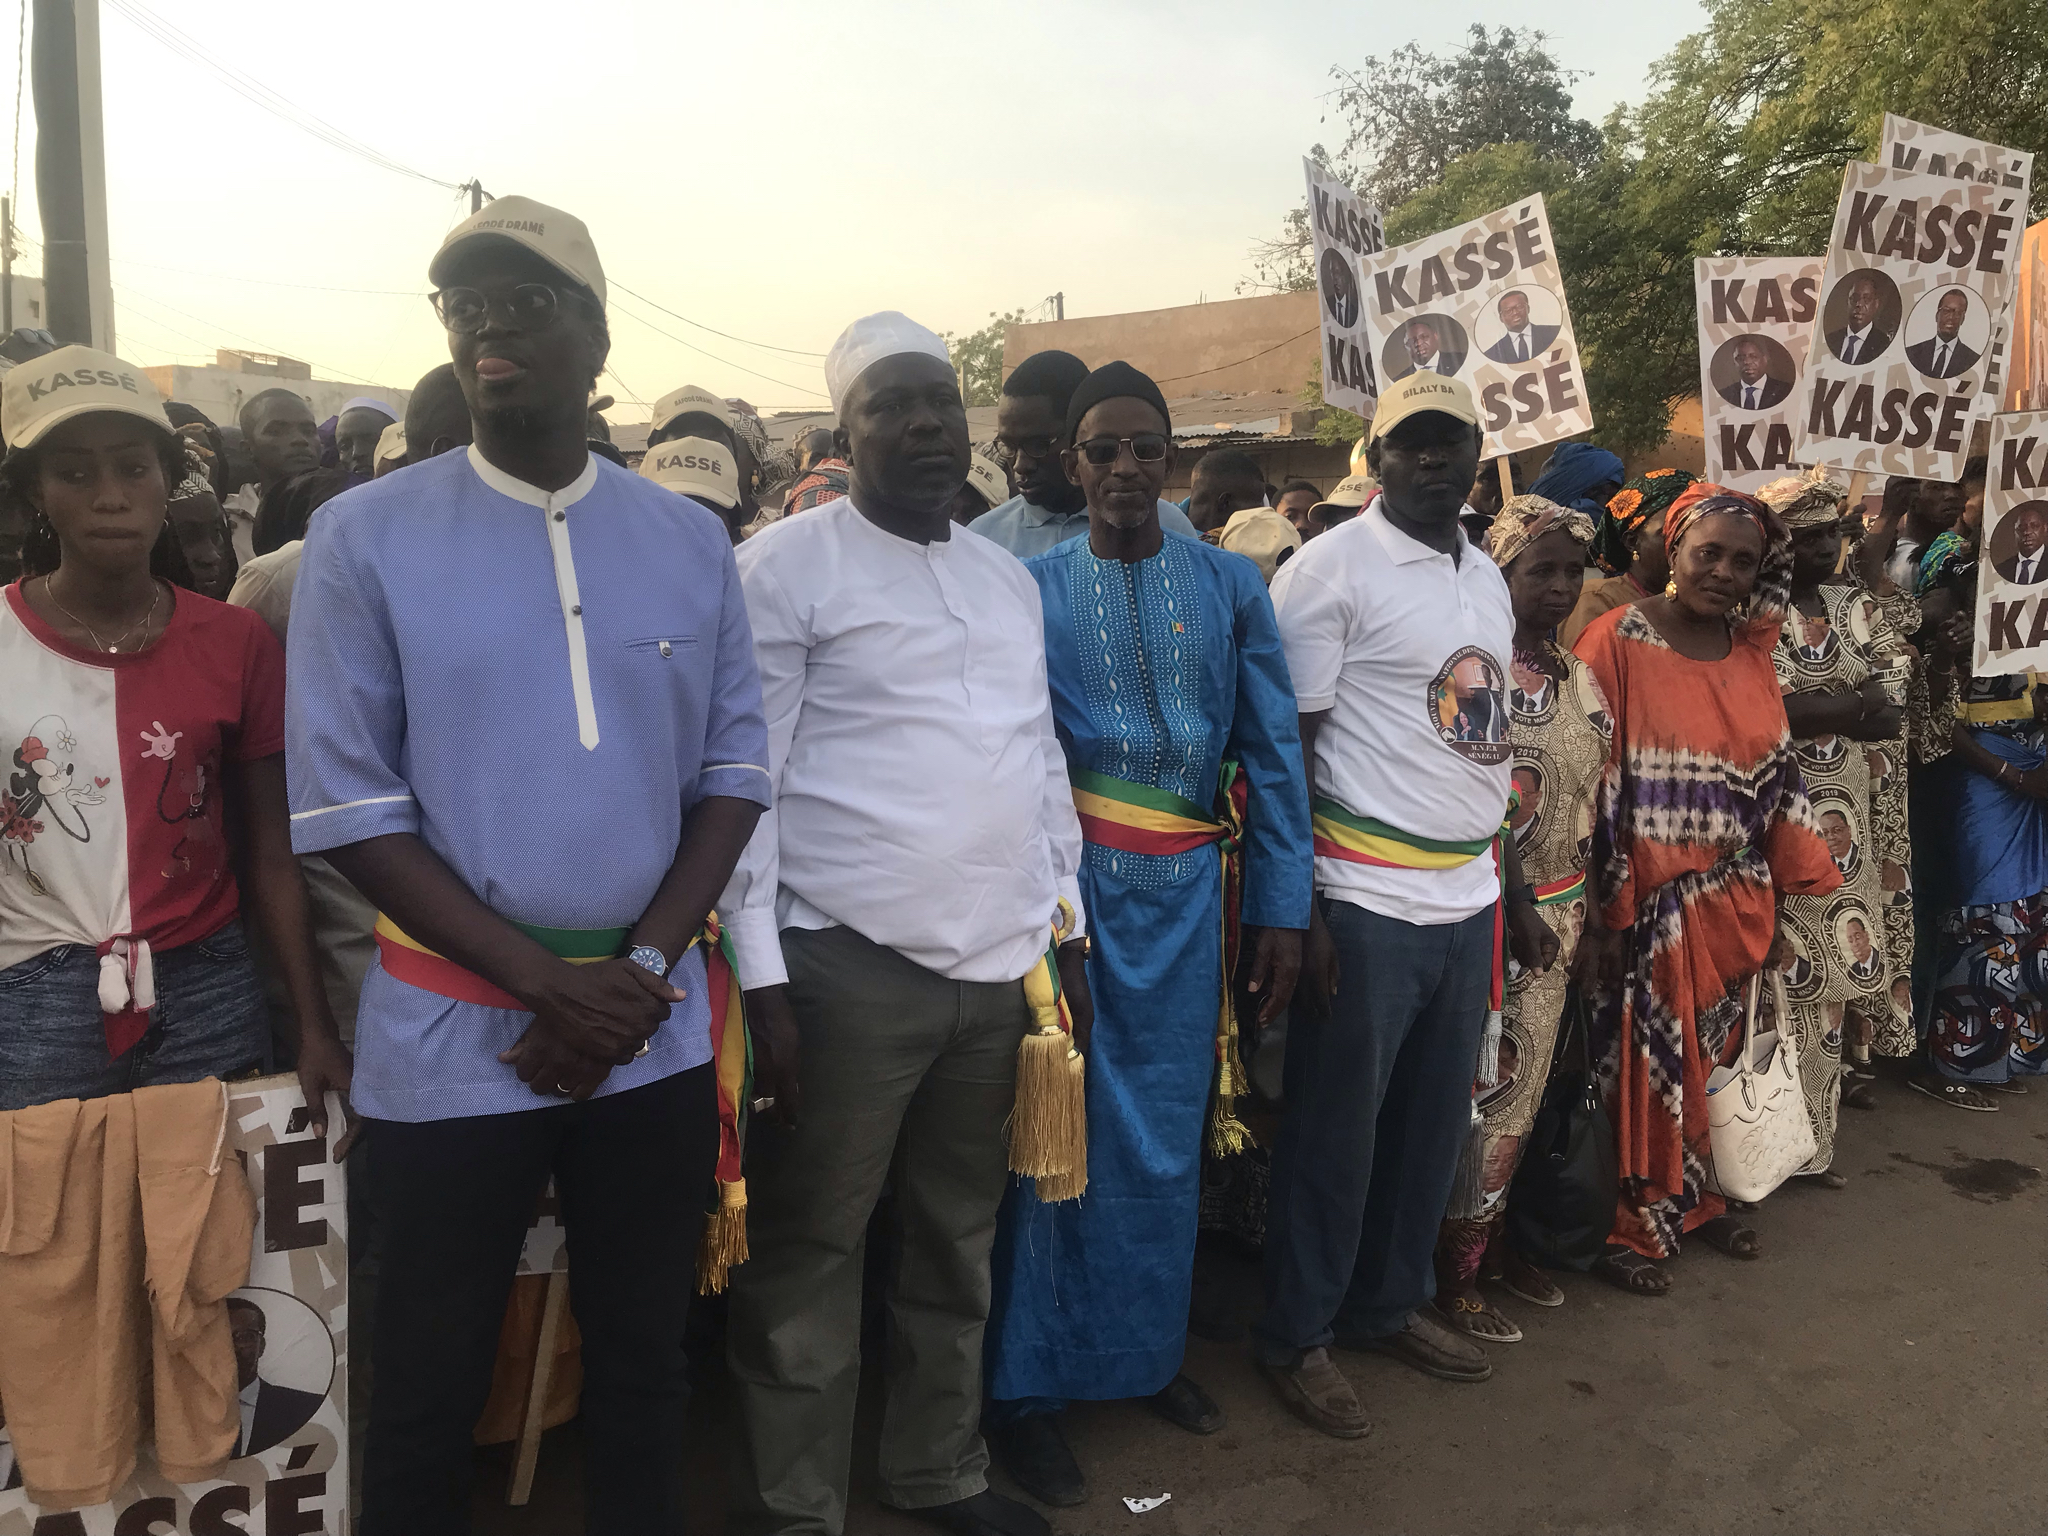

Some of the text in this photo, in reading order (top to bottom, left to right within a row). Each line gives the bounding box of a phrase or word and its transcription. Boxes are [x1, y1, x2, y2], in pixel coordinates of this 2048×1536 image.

[1312, 184, 1383, 255] KASSÉ
[1842, 190, 2015, 274] KASSÉ
[1374, 204, 1548, 316] KASSÉ
[27, 369, 139, 402] KASSÉ
[1402, 384, 1456, 400] BILALY BA
[1807, 377, 1972, 454] KASSÉ
[656, 455, 722, 477] KASSÉ
[1516, 747, 1539, 758] 2019
[1810, 764, 1828, 772] VOTE
[1820, 789, 1839, 798] 2019
